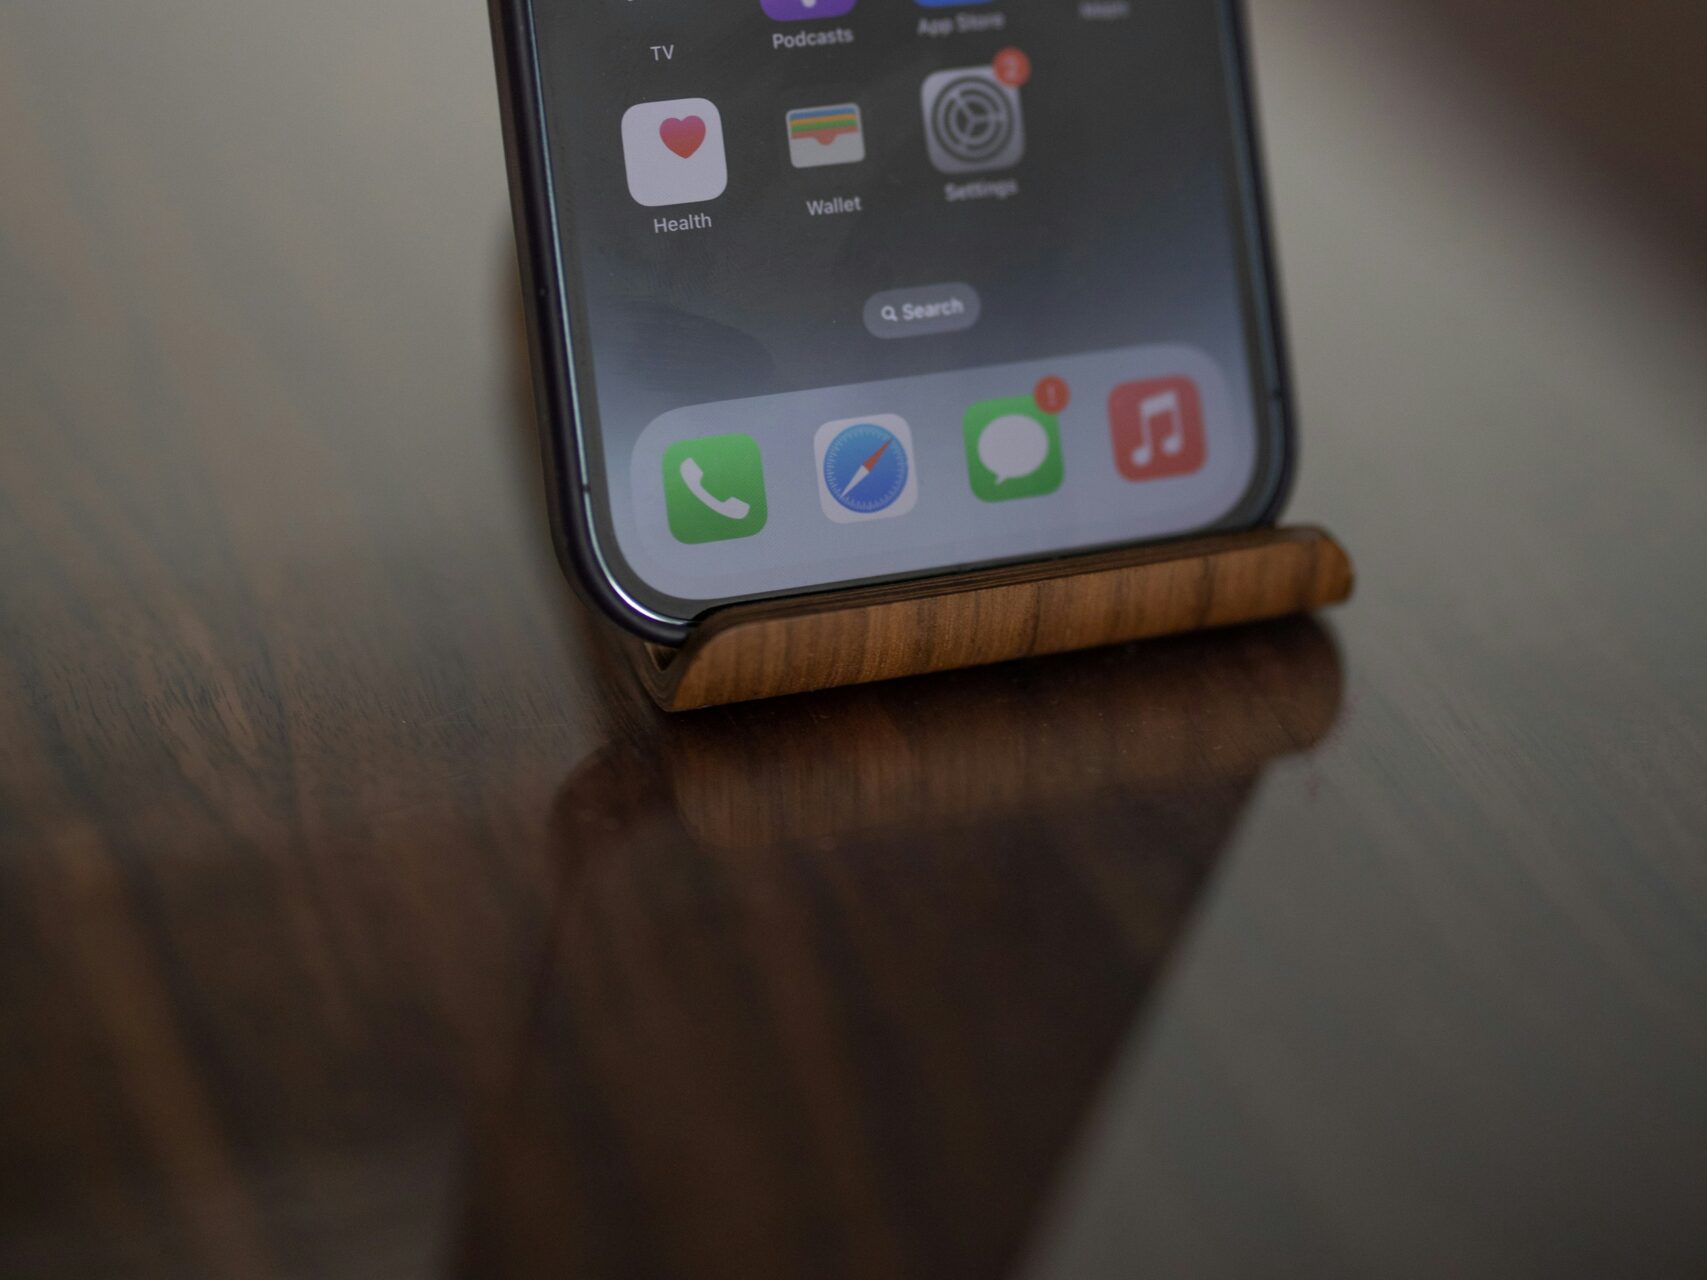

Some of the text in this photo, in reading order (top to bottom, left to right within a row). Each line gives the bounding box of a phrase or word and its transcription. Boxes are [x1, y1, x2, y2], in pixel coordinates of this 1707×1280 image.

[772, 28, 855, 49] Podcasts
[650, 44, 674, 61] TV
[806, 196, 862, 217] Wallet
[654, 212, 713, 234] Health
[902, 298, 964, 321] Search
